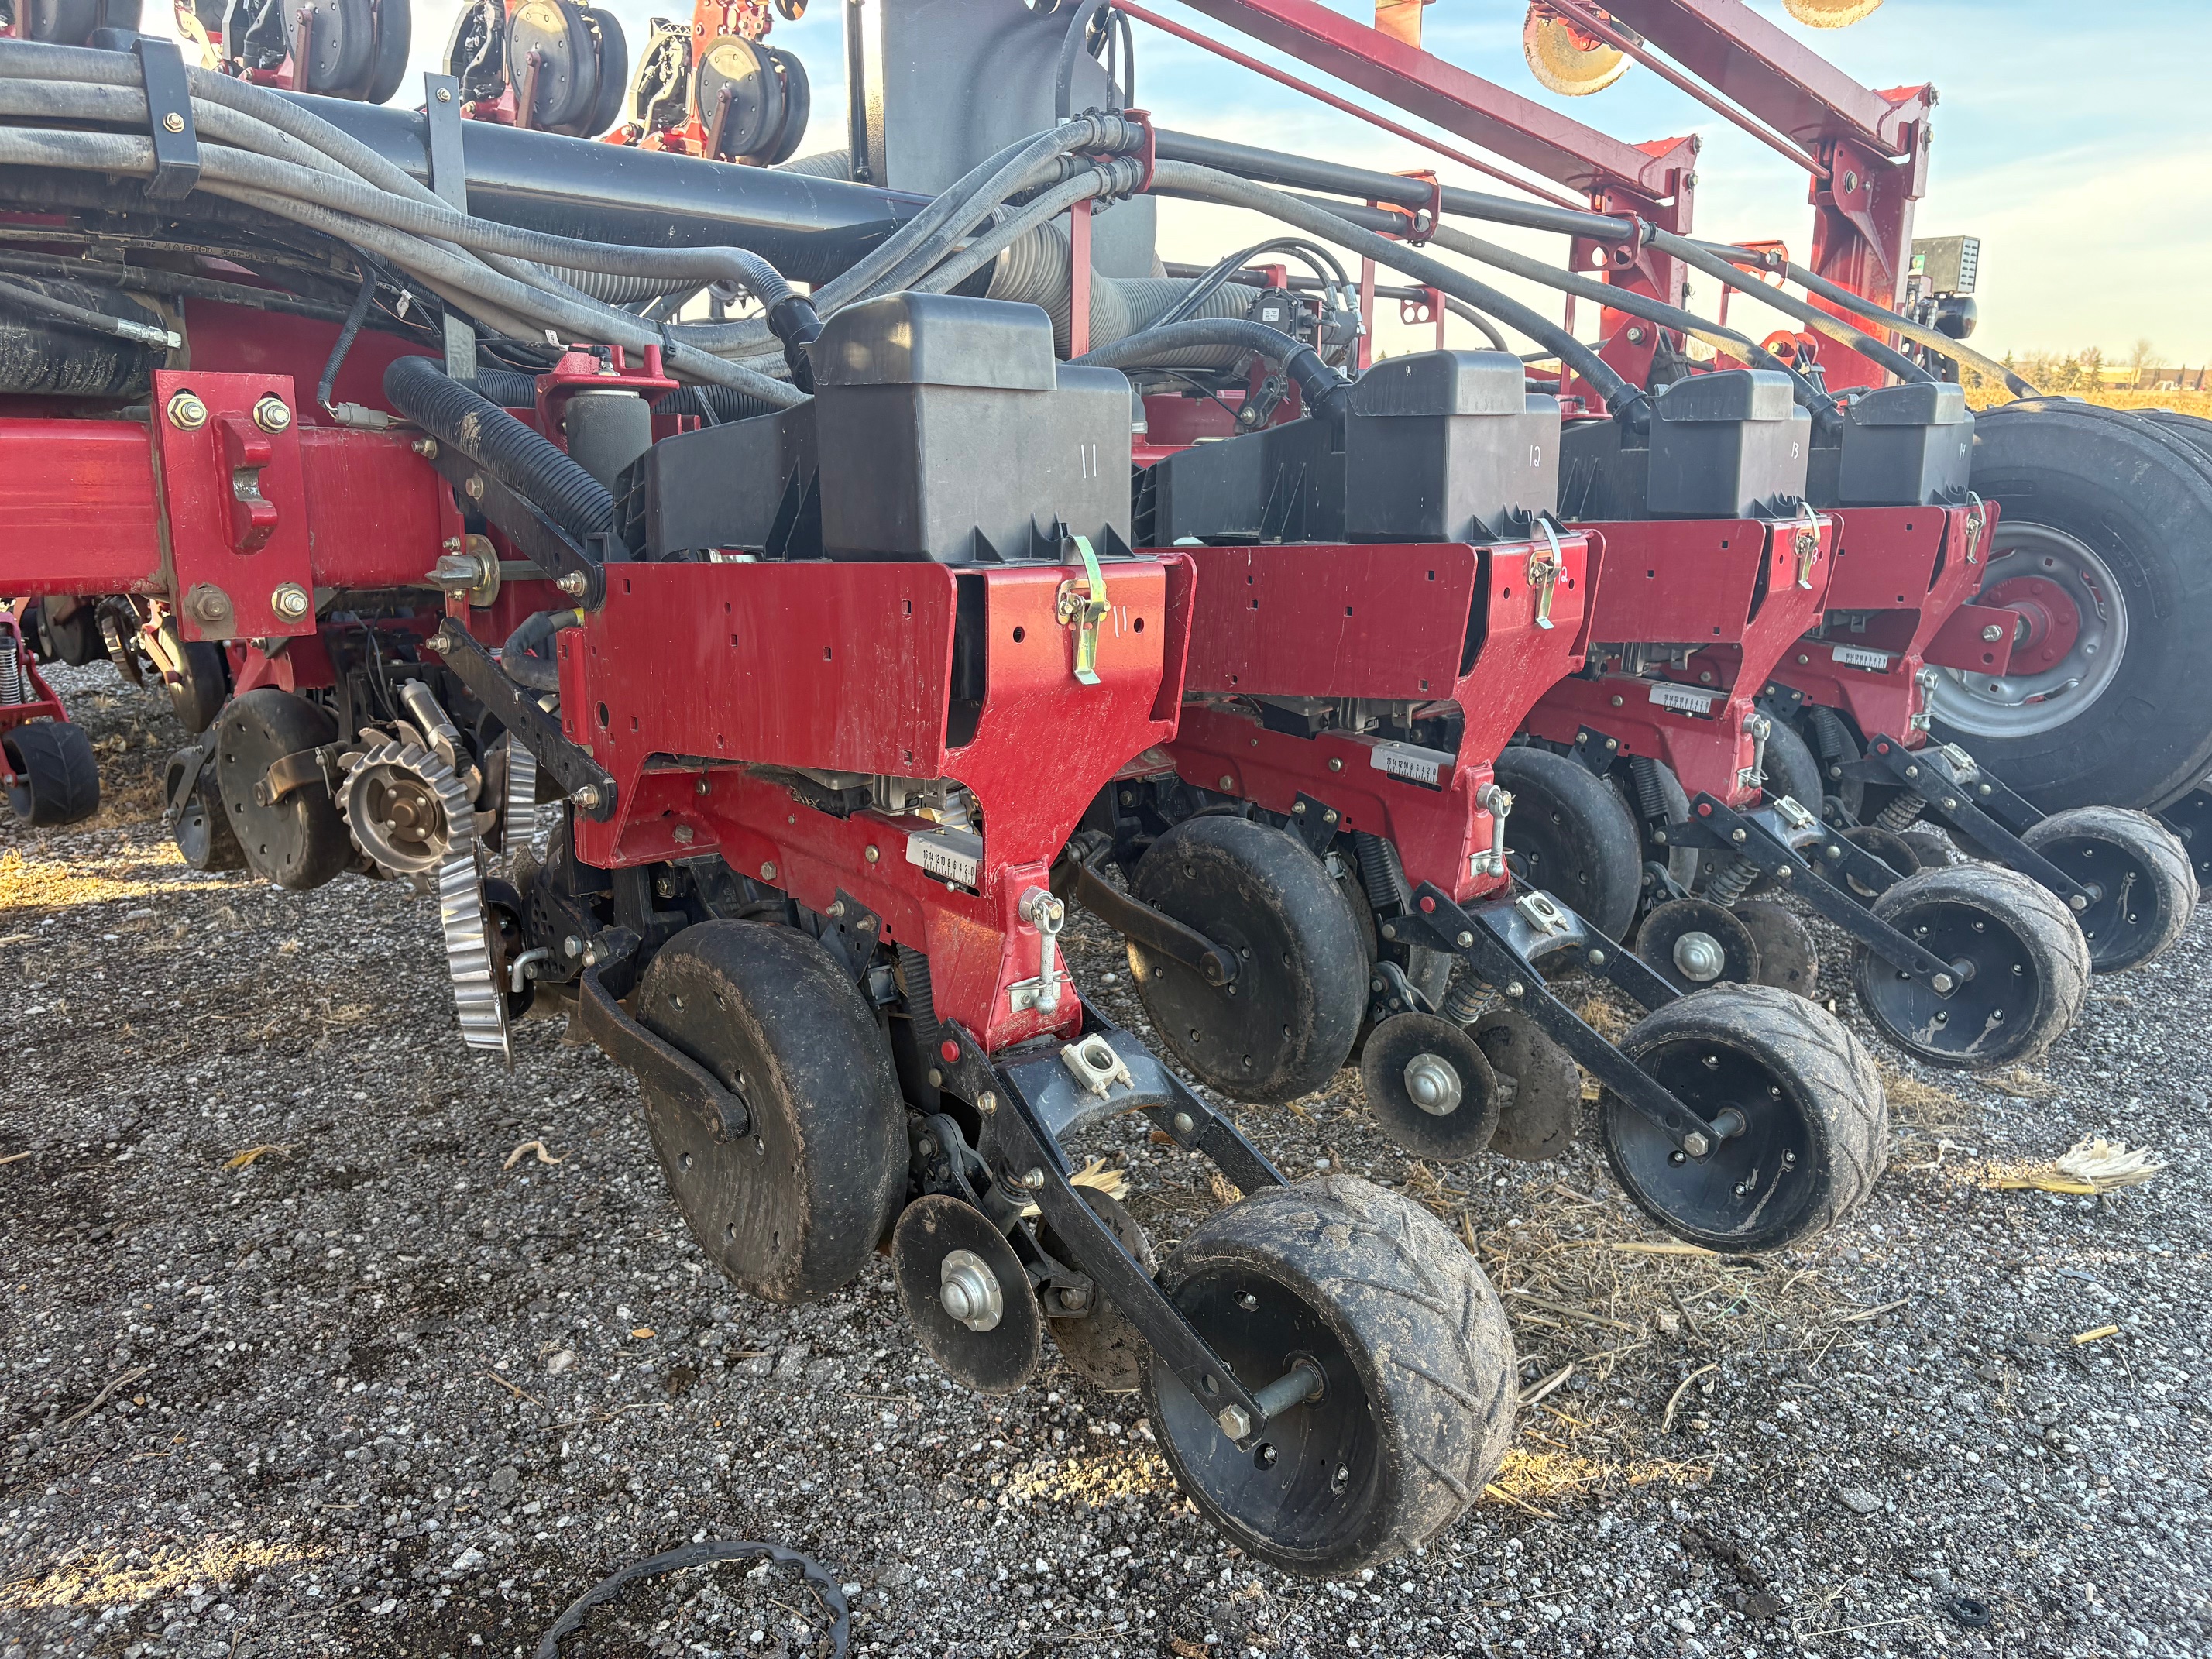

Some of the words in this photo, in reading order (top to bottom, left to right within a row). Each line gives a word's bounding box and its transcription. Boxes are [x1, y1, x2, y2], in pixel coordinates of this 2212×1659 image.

[1081, 444, 1097, 479] 11
[1530, 445, 1540, 467] 12
[1791, 441, 1799, 459] 13
[1113, 606, 1127, 638] 11
[1398, 760, 1403, 768] 12
[923, 850, 928, 860] 16
[929, 852, 933, 861] 14
[935, 854, 939, 864] 12
[940, 856, 945, 866] 10
[947, 858, 950, 867] 8
[953, 860, 957, 870] 6
[959, 863, 963, 872] 4
[965, 864, 967, 874] 2
[970, 867, 974, 876] 0
